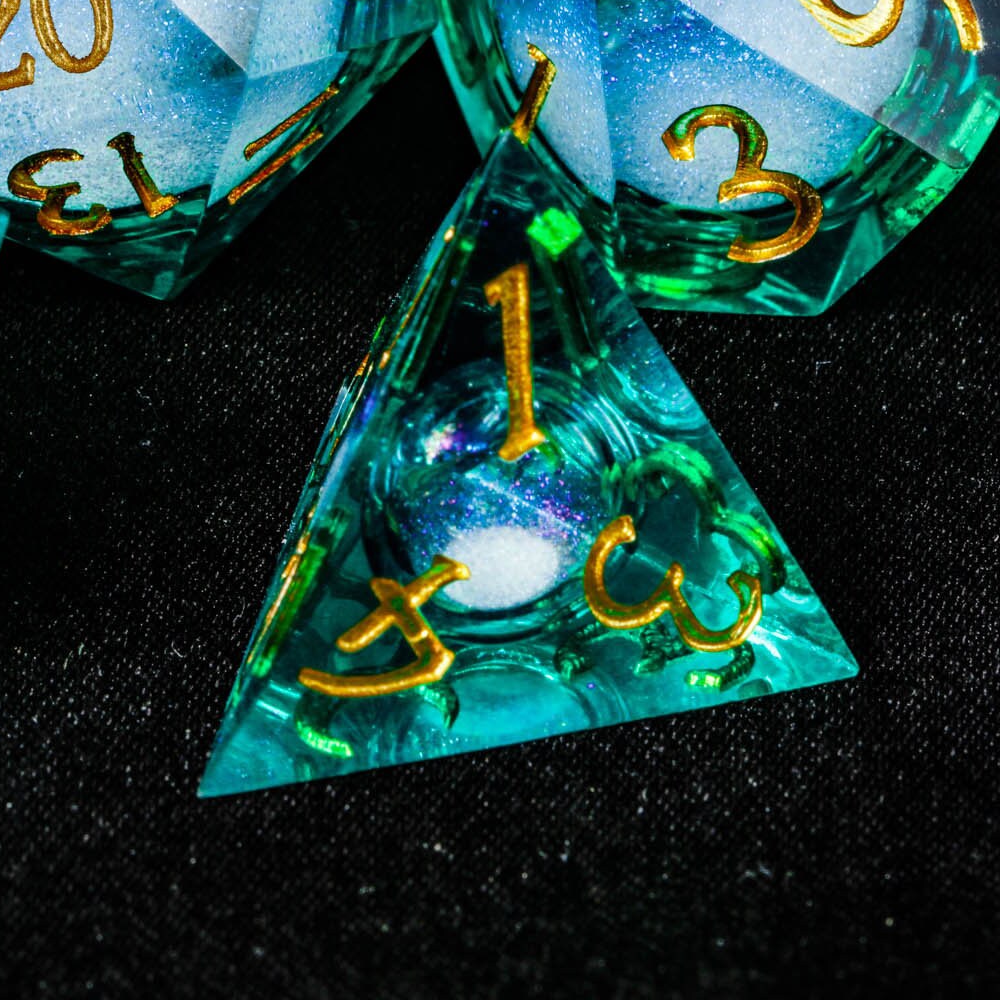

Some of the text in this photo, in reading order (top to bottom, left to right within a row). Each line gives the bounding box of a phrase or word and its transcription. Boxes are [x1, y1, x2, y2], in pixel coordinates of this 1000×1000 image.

[7, 130, 180, 236] 13
[661, 103, 824, 264] 3
[484, 262, 546, 463] 1
[299, 554, 471, 697] 4
[584, 514, 763, 652] 3
